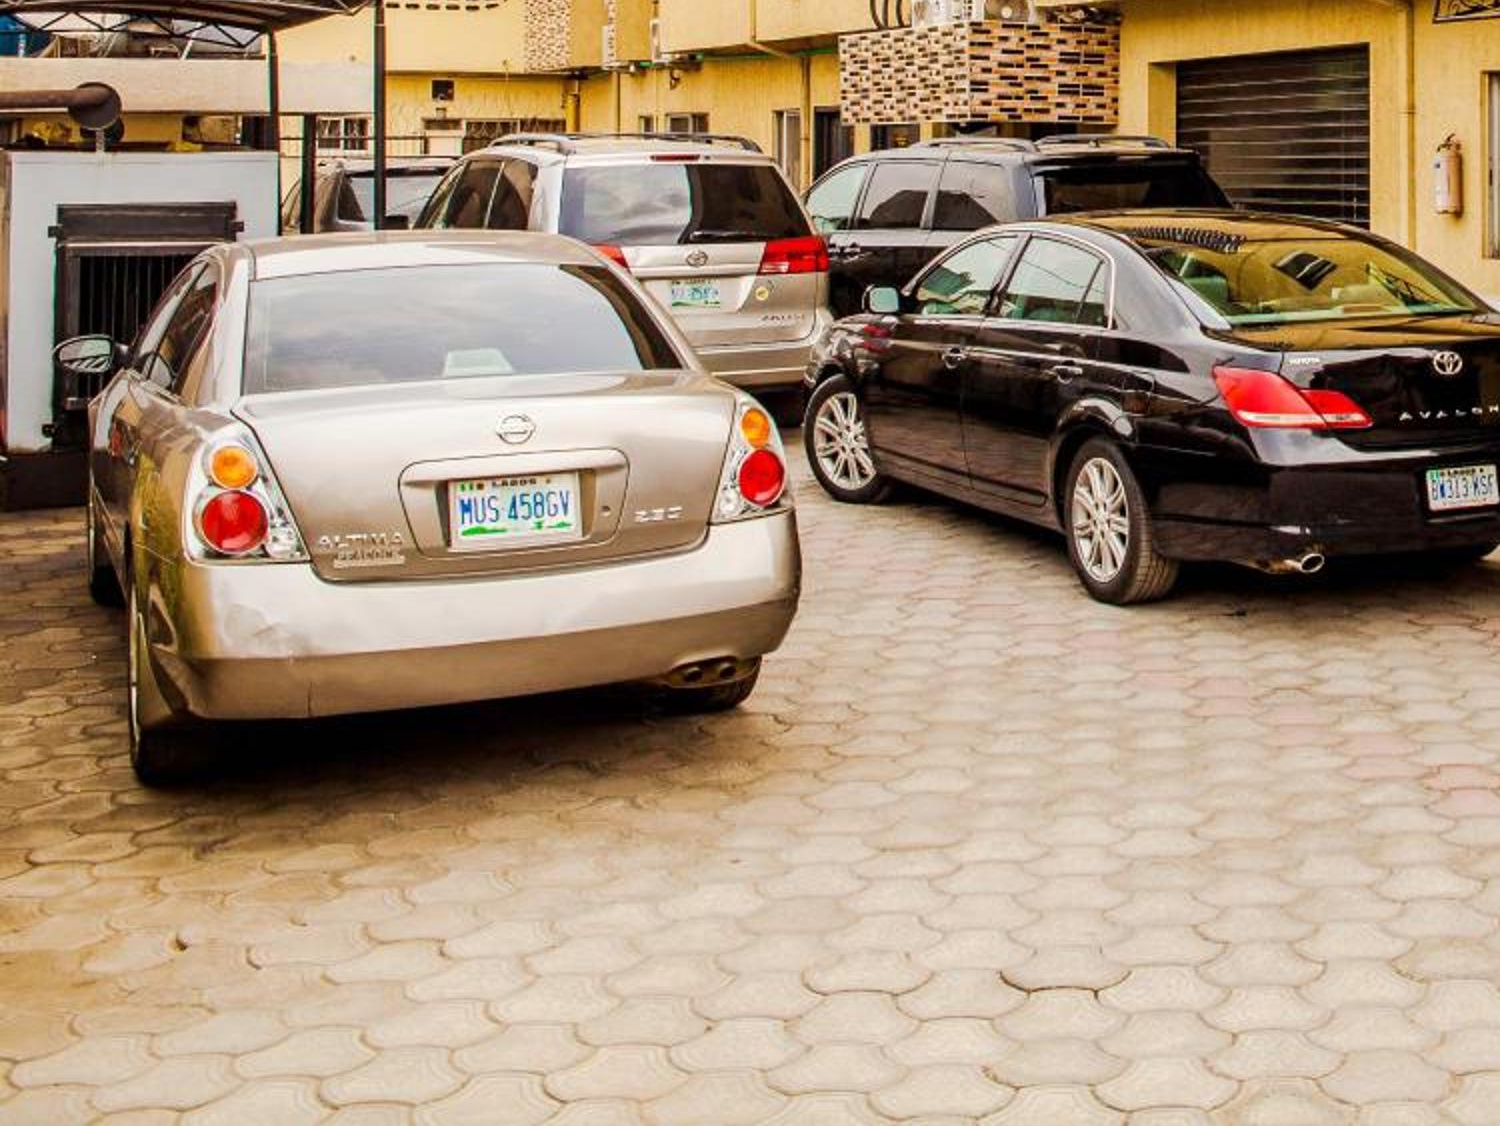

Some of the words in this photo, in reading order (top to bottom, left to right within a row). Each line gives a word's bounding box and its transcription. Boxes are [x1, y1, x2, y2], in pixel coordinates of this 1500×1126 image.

[1399, 405, 1499, 421] AVALON
[460, 495, 500, 525] MUS
[507, 489, 570, 521] 458GV
